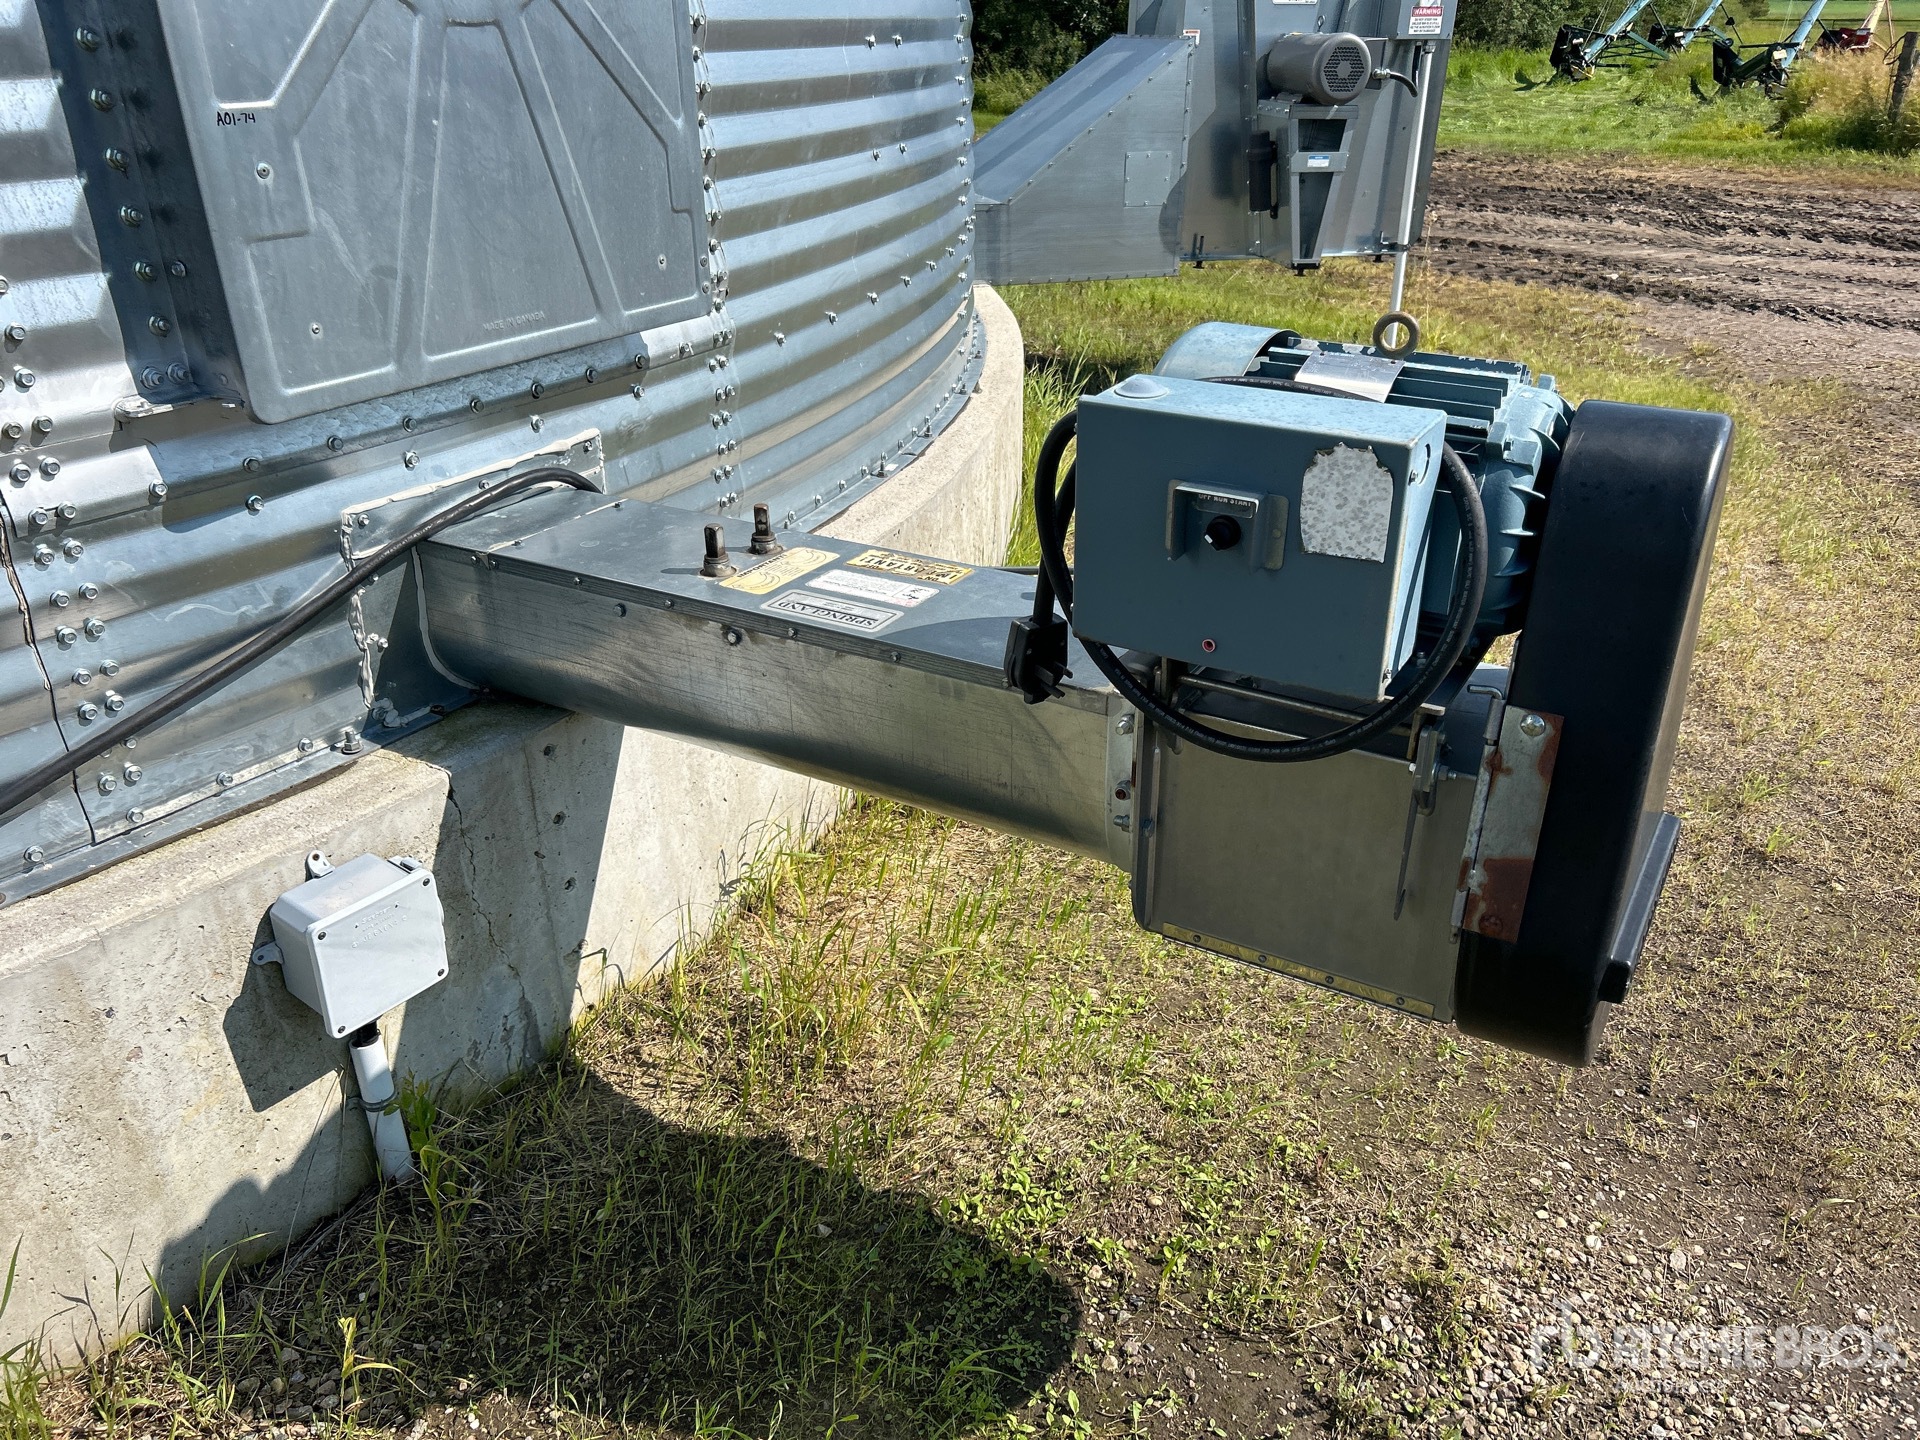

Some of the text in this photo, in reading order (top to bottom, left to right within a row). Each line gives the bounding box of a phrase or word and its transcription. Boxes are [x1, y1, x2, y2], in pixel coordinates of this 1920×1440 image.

[482, 310, 546, 331] MADE IN CANADA
[777, 601, 876, 627] SPRINGLAND
